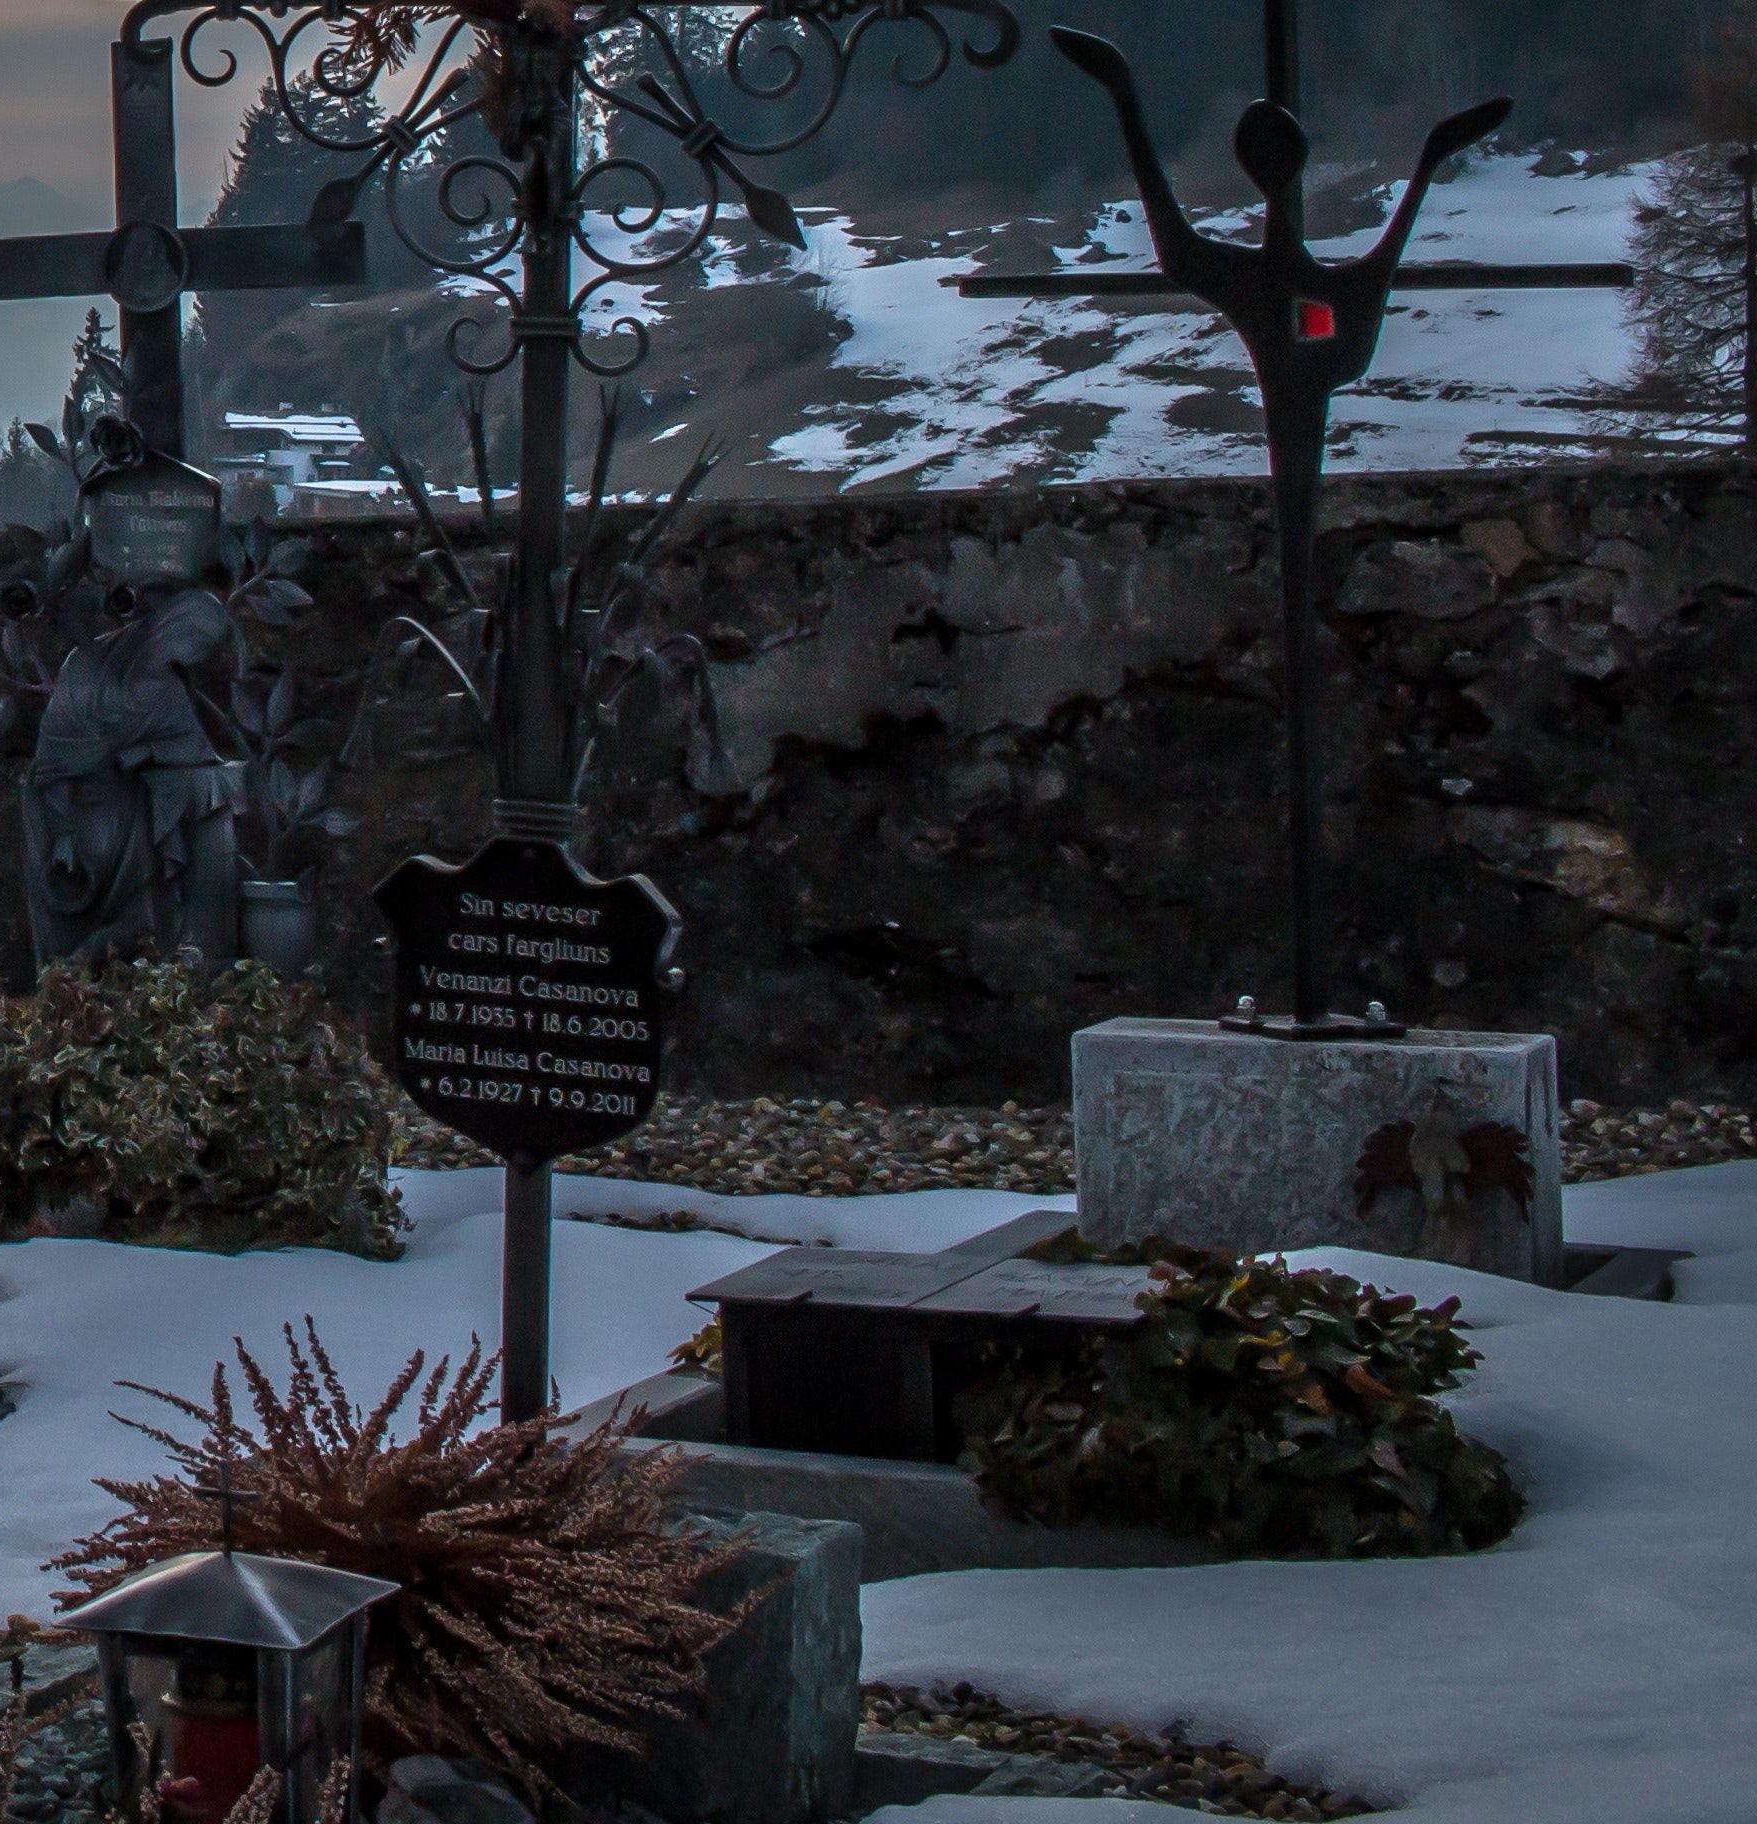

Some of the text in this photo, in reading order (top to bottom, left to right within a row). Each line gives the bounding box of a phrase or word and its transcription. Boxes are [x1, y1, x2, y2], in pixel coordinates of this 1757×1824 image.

[459, 891, 601, 926] Sin seveser
[448, 932, 612, 965] cars fargliuns
[419, 964, 639, 1008] Venanzi Casanova
[404, 1037, 651, 1082] Maria Luisa Casanova
